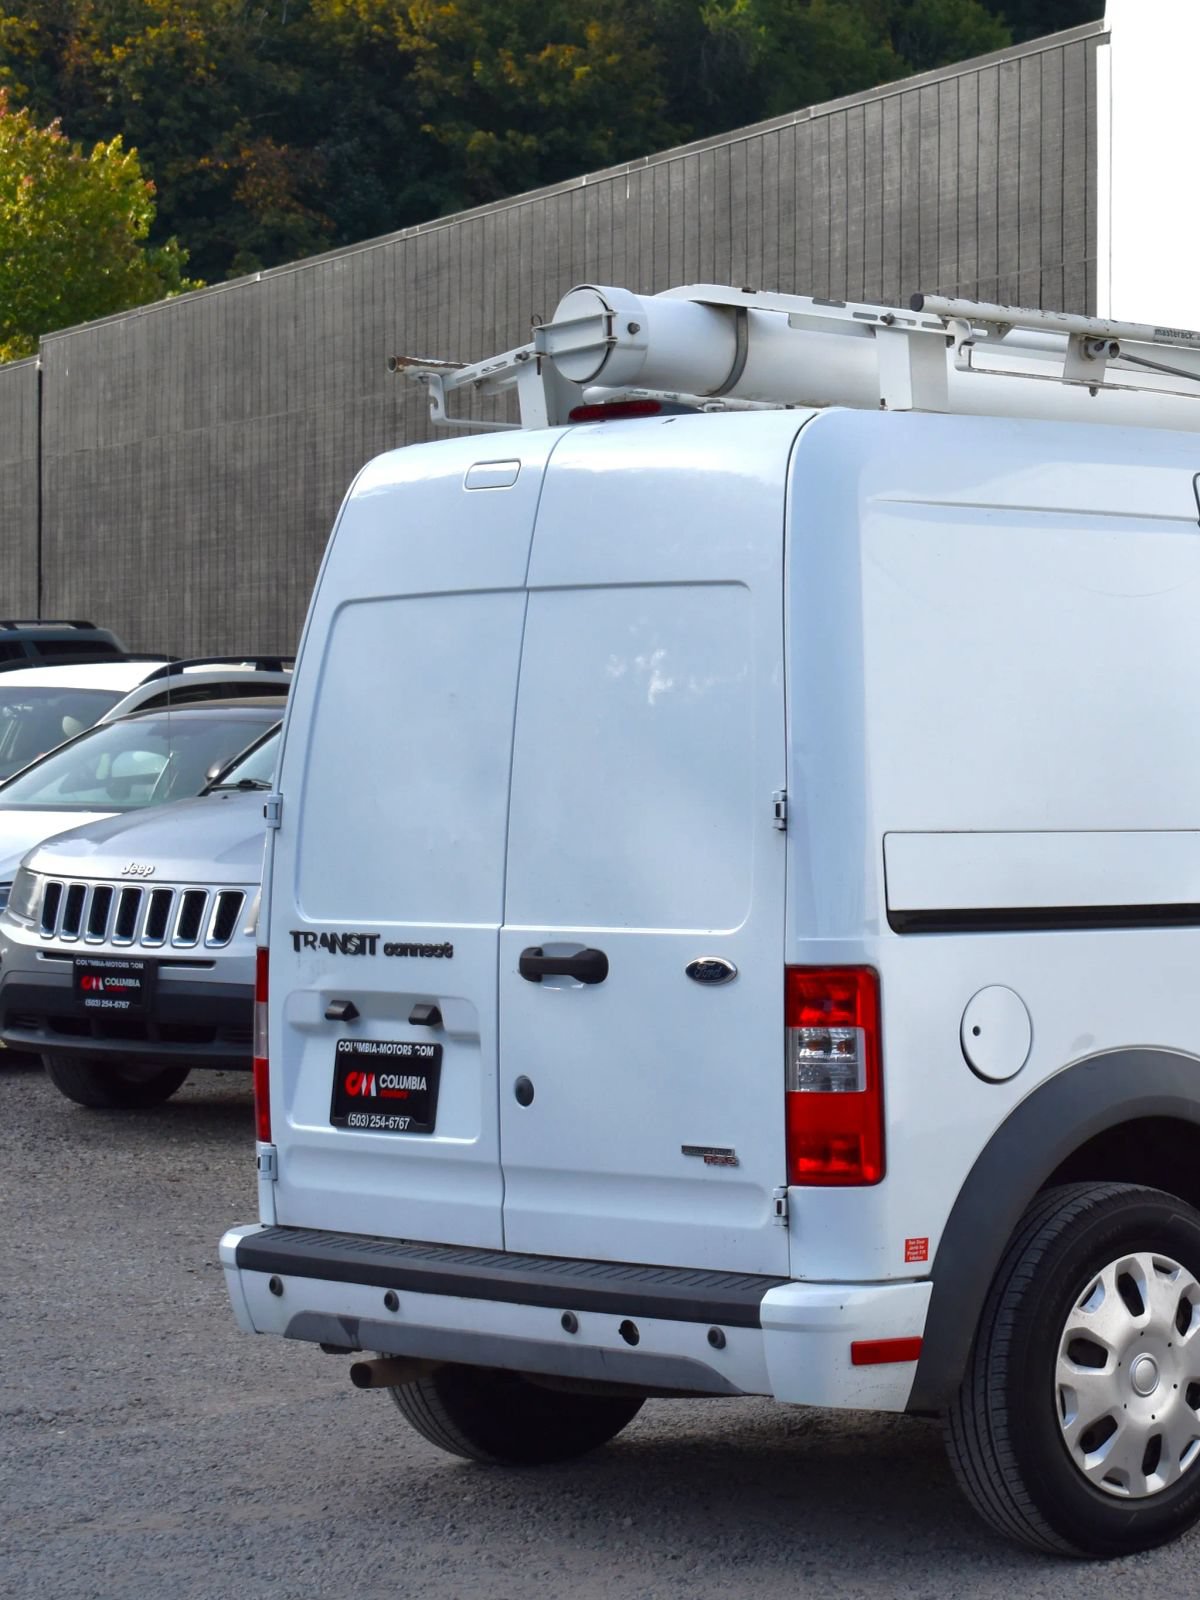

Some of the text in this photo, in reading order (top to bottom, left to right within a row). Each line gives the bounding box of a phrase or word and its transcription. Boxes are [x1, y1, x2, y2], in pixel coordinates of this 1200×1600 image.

[121, 862, 155, 877] Jeep
[289, 930, 454, 959] TRANSIT connect
[105, 977, 141, 988] COLUMBIA
[380, 1074, 427, 1091] COLUMBIA
[348, 1113, 410, 1130] (503) 254-6767
